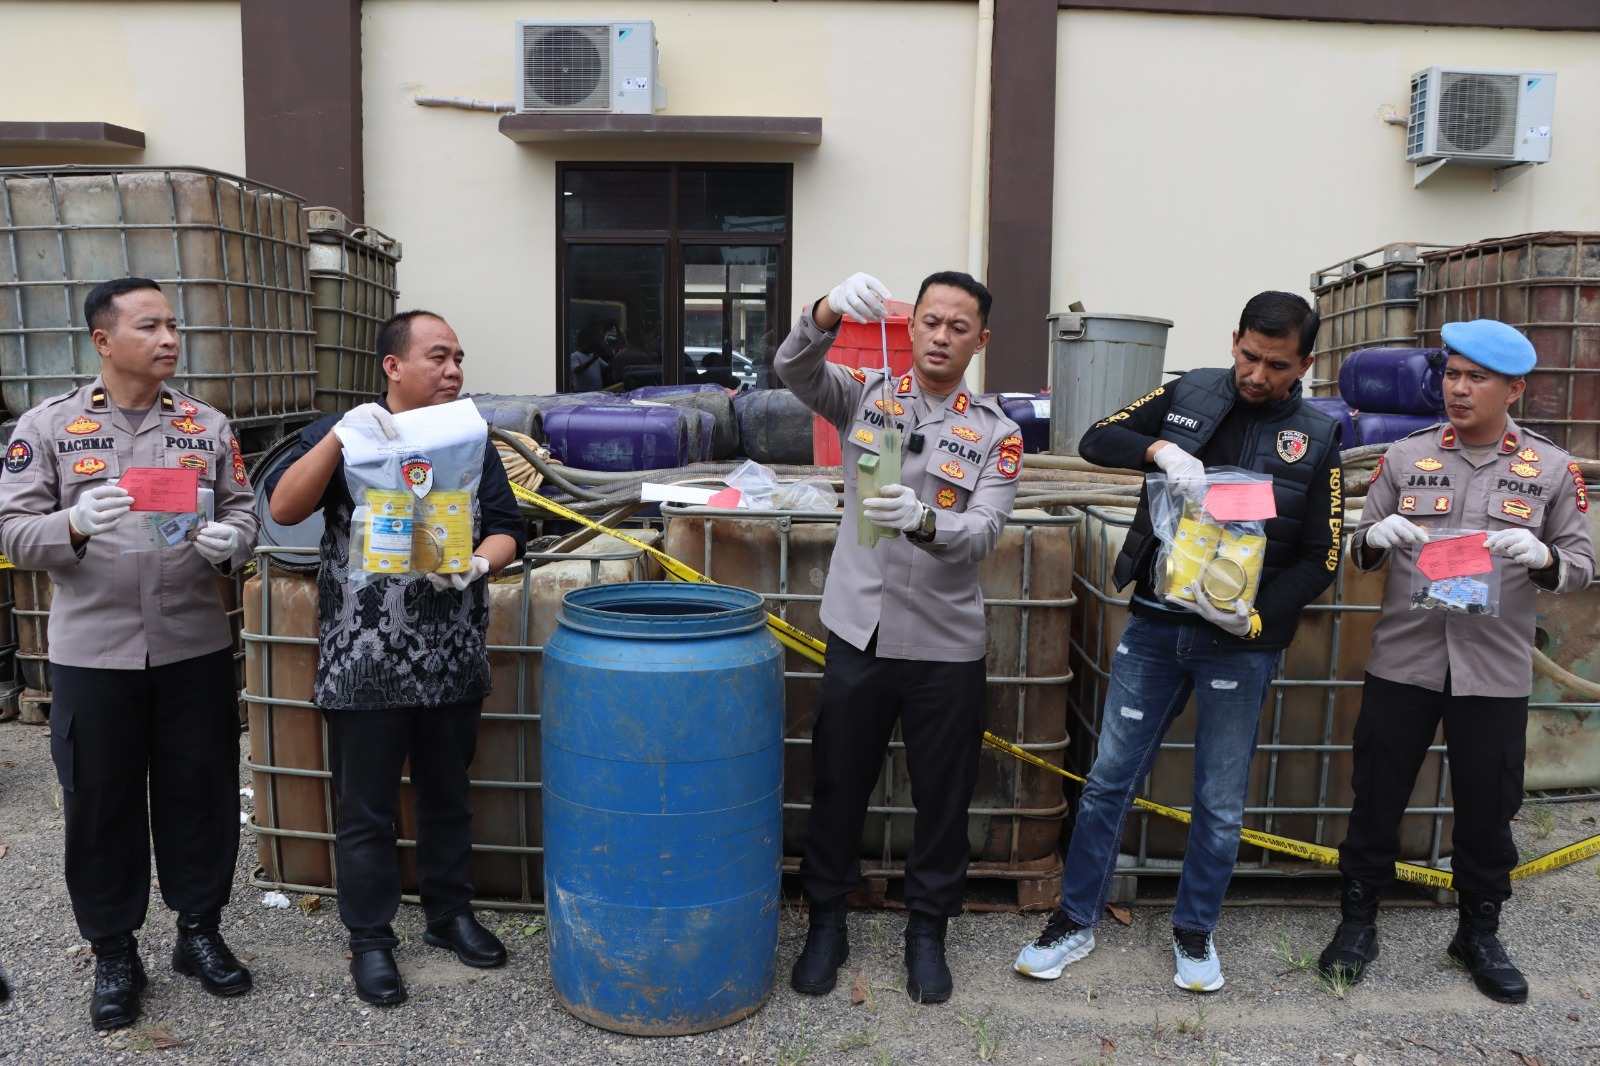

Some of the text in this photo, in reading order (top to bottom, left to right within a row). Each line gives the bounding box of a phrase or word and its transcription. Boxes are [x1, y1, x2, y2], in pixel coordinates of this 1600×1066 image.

[1166, 412, 1198, 429] DEFRI
[57, 437, 115, 453] RACHMAT
[165, 436, 215, 452] POLRI
[938, 439, 982, 465] POLRI
[1407, 475, 1451, 487] JAKA
[1497, 478, 1544, 497] POLRI
[1329, 467, 1342, 516] ROYAL
[1410, 870, 1428, 885] GARIS
[1429, 874, 1450, 889] POLISI
